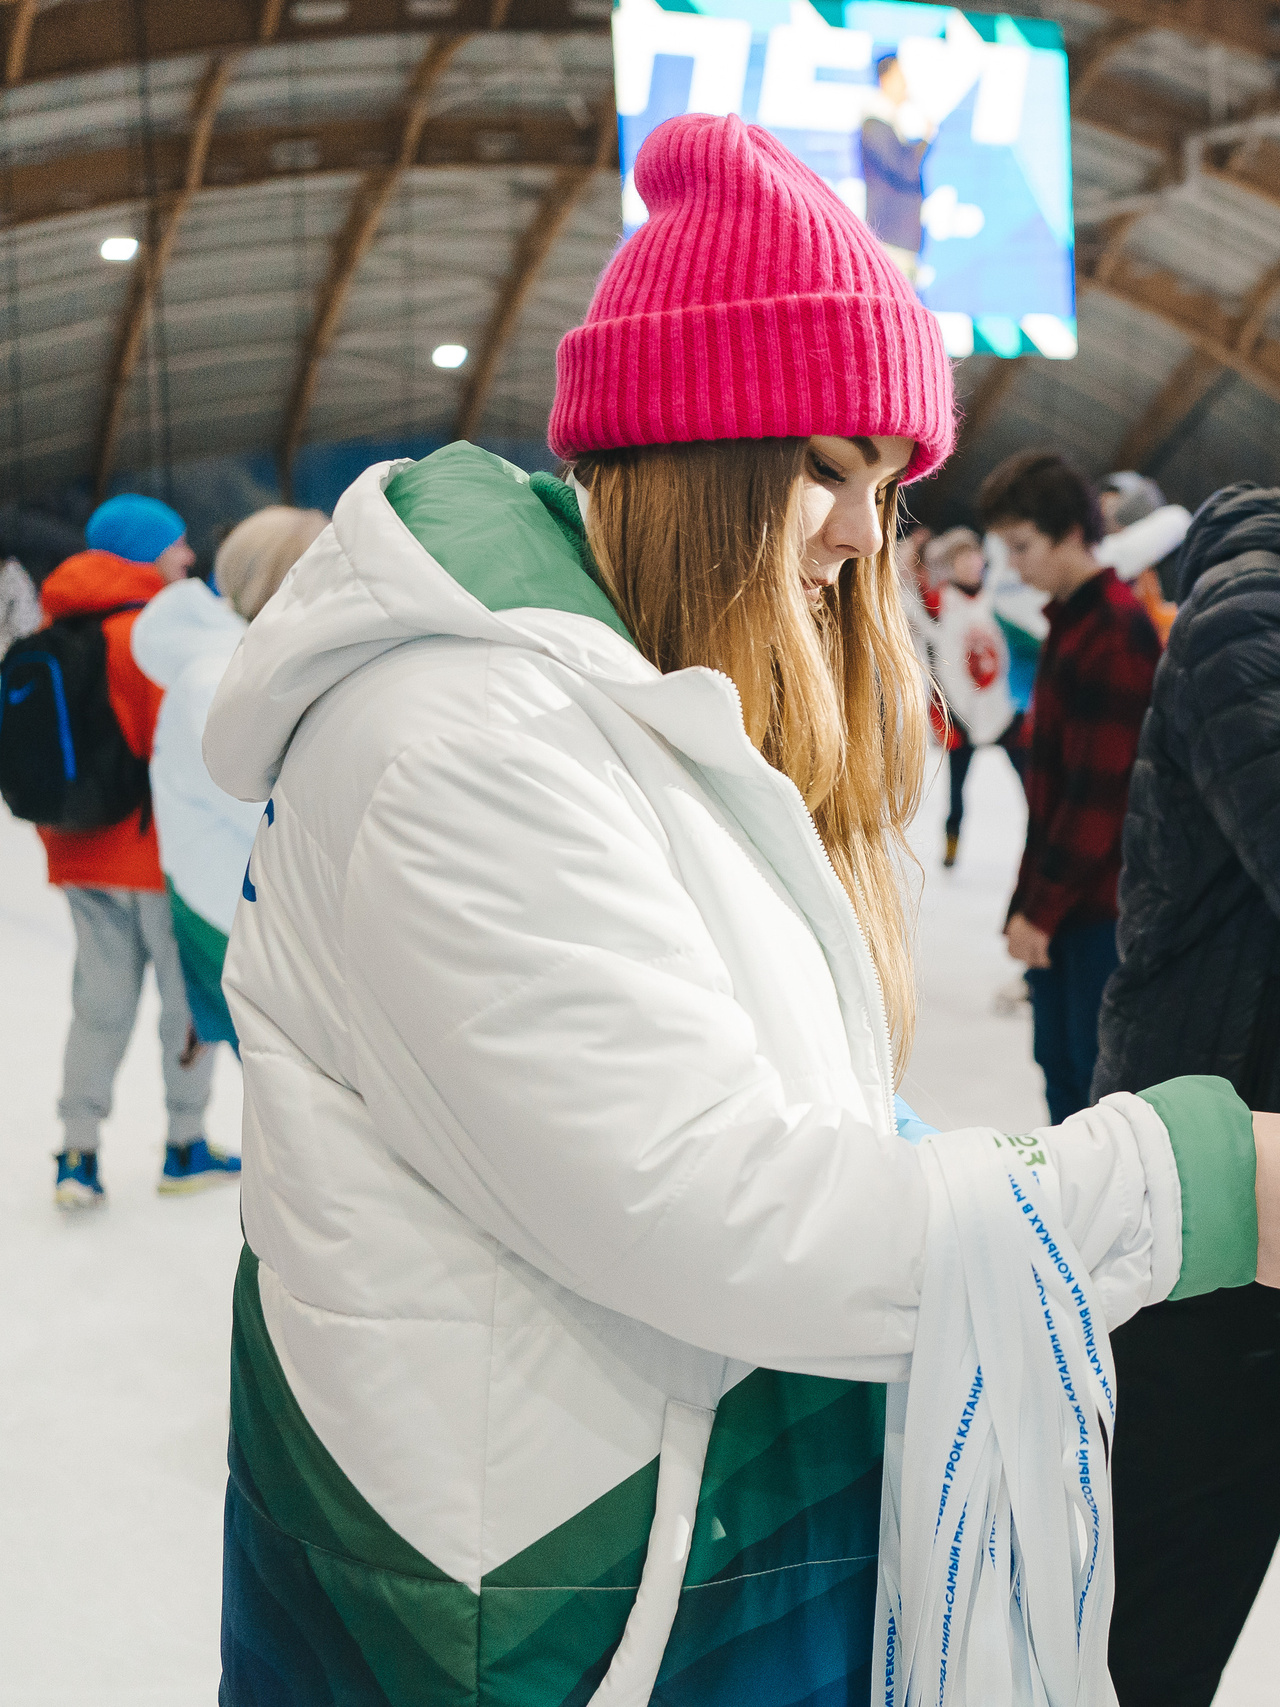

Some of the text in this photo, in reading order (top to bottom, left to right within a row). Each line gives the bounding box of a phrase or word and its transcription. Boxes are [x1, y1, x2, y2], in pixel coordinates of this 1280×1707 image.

[1021, 1203, 1034, 1215] В
[1028, 1214, 1075, 1285] КОНЬКАХ
[1071, 1283, 1087, 1307] НА
[1079, 1306, 1103, 1376] КАТАНИЯ
[1072, 1404, 1089, 1446] УРОК
[944, 1438, 966, 1482] УРОК
[1075, 1449, 1100, 1528] МАССОВЫЙ
